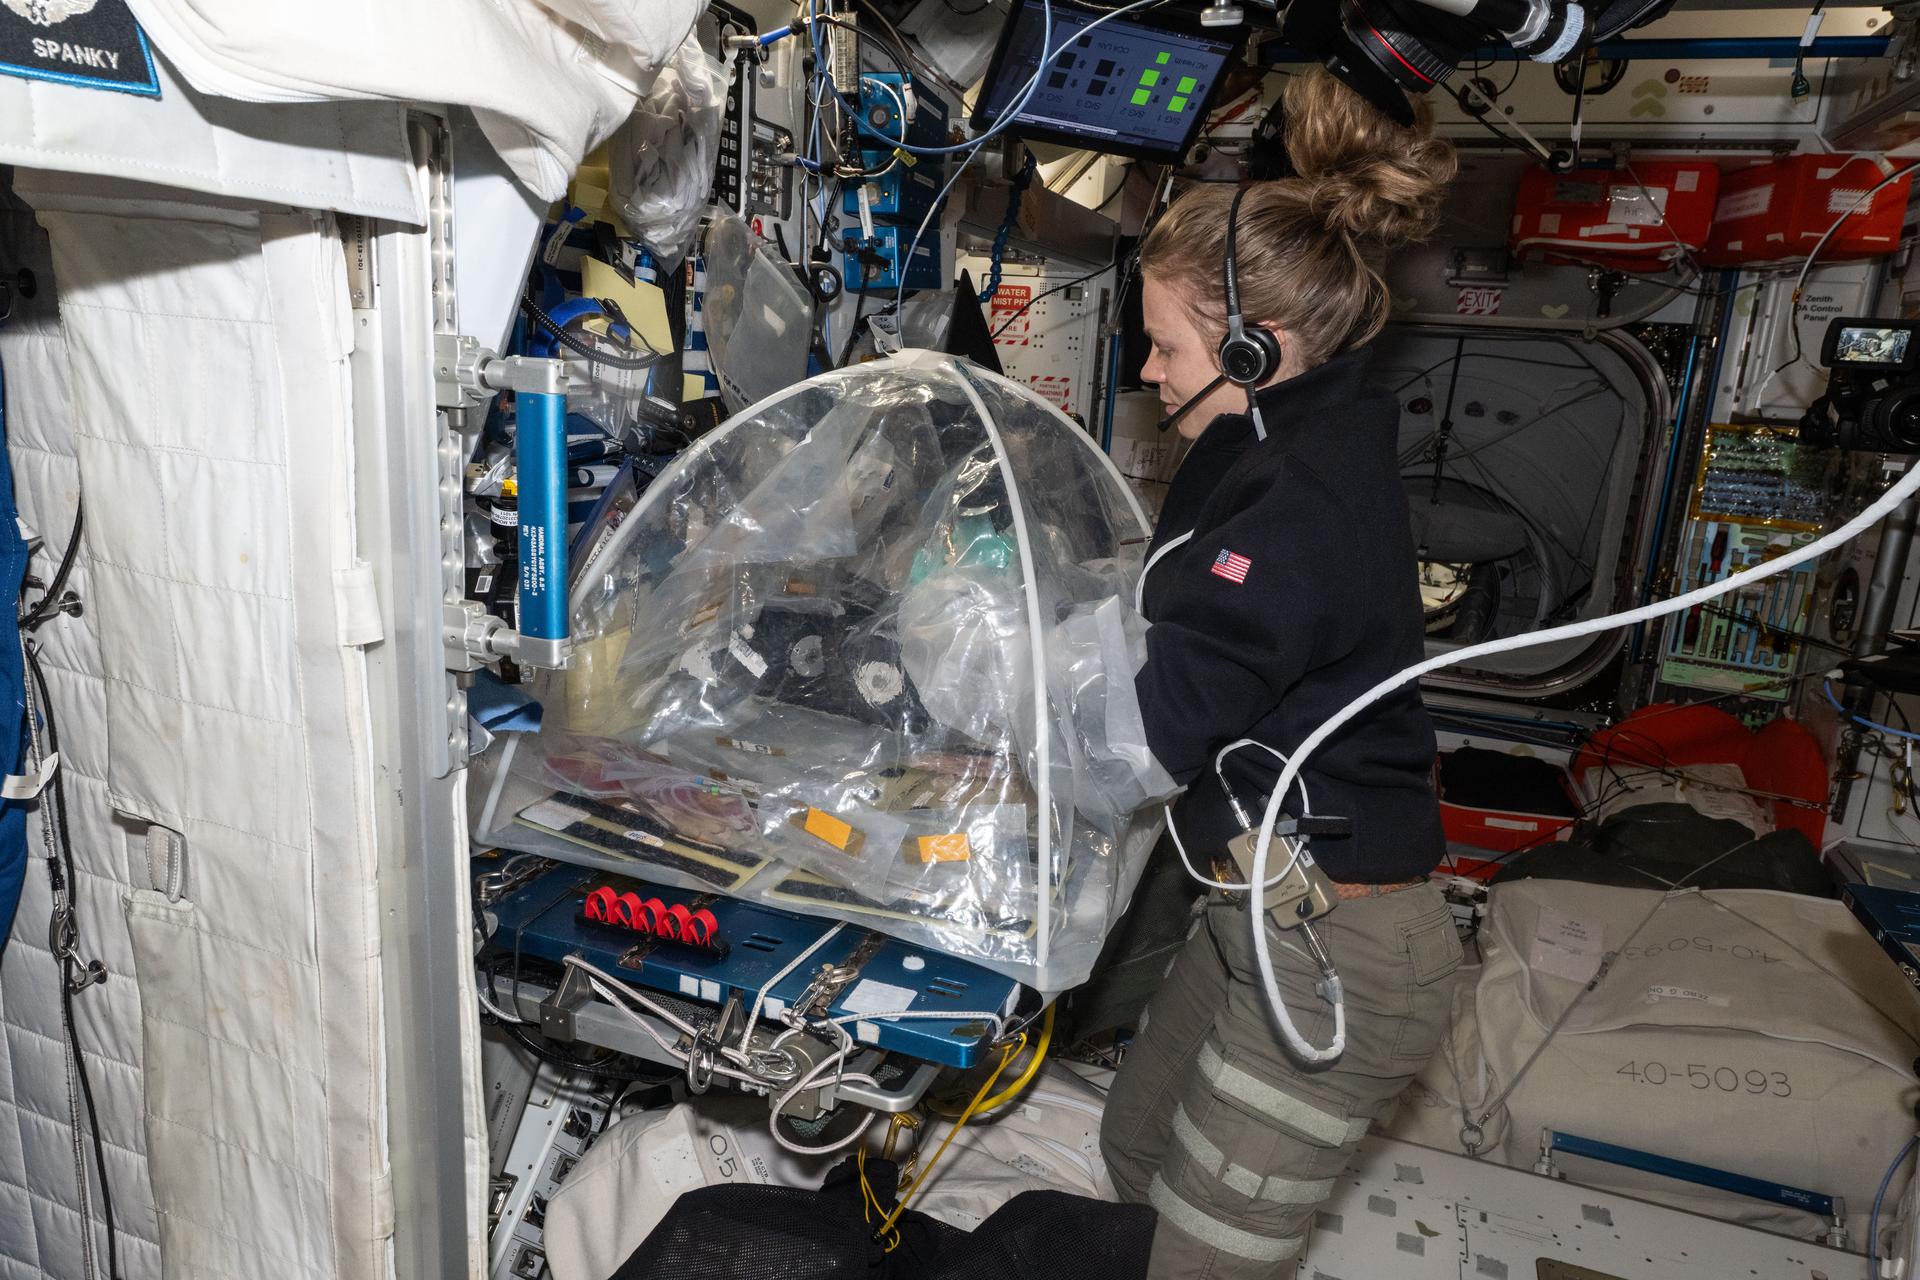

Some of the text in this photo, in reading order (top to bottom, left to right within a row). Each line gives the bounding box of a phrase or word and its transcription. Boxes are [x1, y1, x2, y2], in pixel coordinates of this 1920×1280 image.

[32, 37, 119, 70] SPANKY
[996, 287, 1027, 297] WATER
[993, 298, 1013, 306] MIST
[1464, 291, 1495, 308] EXIT
[1806, 295, 1833, 303] Zenith
[1810, 304, 1843, 313] Control
[1803, 314, 1828, 322] Panel
[1624, 937, 1784, 963] 4.0-5093
[1616, 1060, 1792, 1098] 4.0-5093
